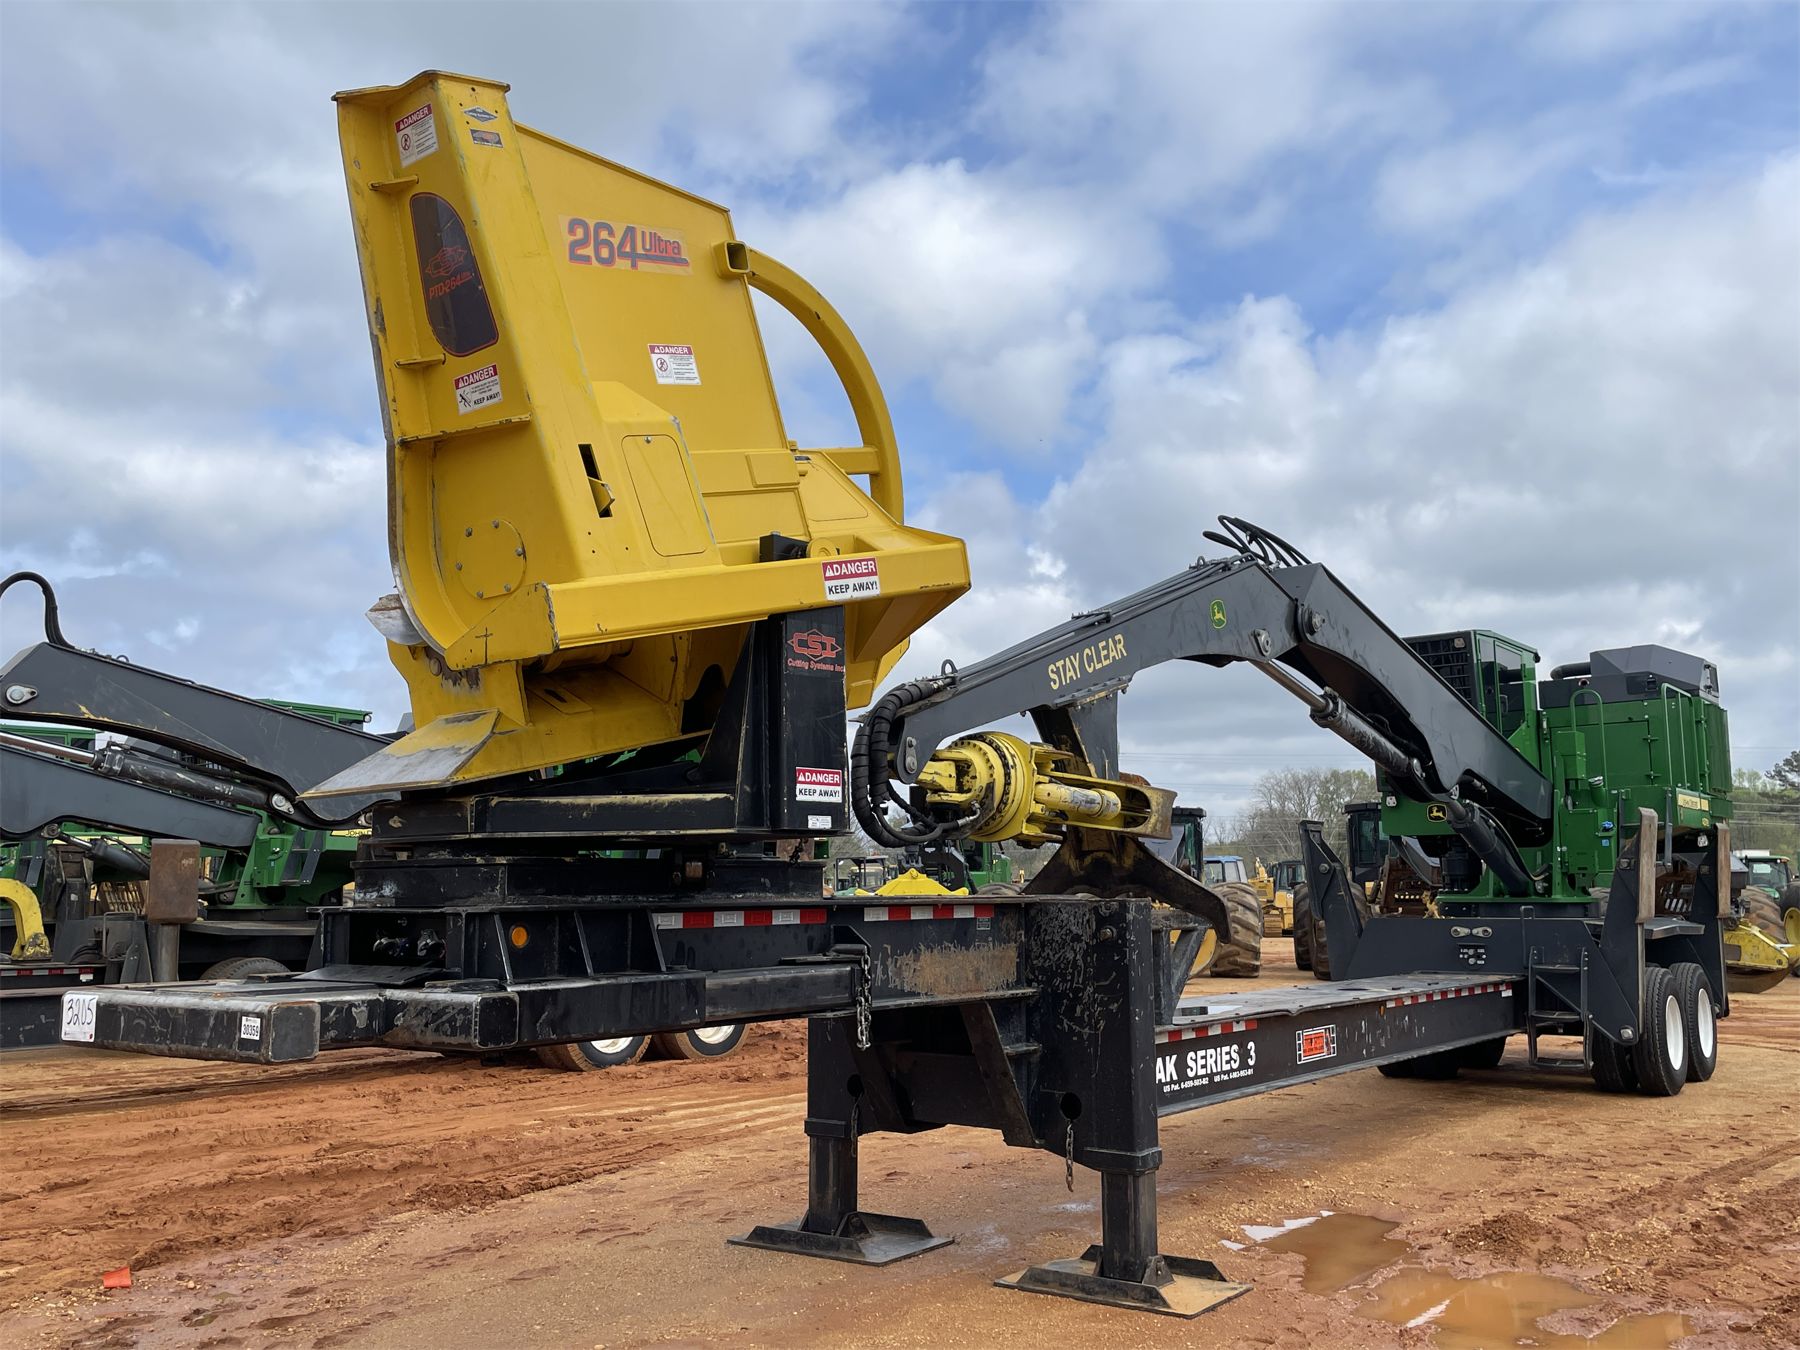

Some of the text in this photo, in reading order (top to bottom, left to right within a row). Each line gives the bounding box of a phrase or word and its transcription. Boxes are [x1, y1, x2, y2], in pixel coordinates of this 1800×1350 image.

[403, 108, 429, 126] DANGER
[568, 218, 681, 270] 264 Ultra
[463, 367, 494, 386] DANGER
[473, 397, 485, 405] KEEP
[832, 561, 876, 576] DANGER
[828, 580, 878, 595] KEEP AWAY!
[793, 632, 837, 658] CSI
[787, 658, 809, 670] Cutting
[810, 661, 834, 671] Systems
[1048, 633, 1128, 690] STAY CLEAR
[805, 772, 840, 783] DANGER
[798, 788, 840, 798] KEEP AWAY!
[66, 997, 96, 1026] 3205
[1186, 1044, 1239, 1077] SERIES
[1247, 1041, 1256, 1066] 3
[1213, 1074, 1221, 1082] US
[1163, 1084, 1171, 1093] US
[1170, 1083, 1181, 1091] Pat.
